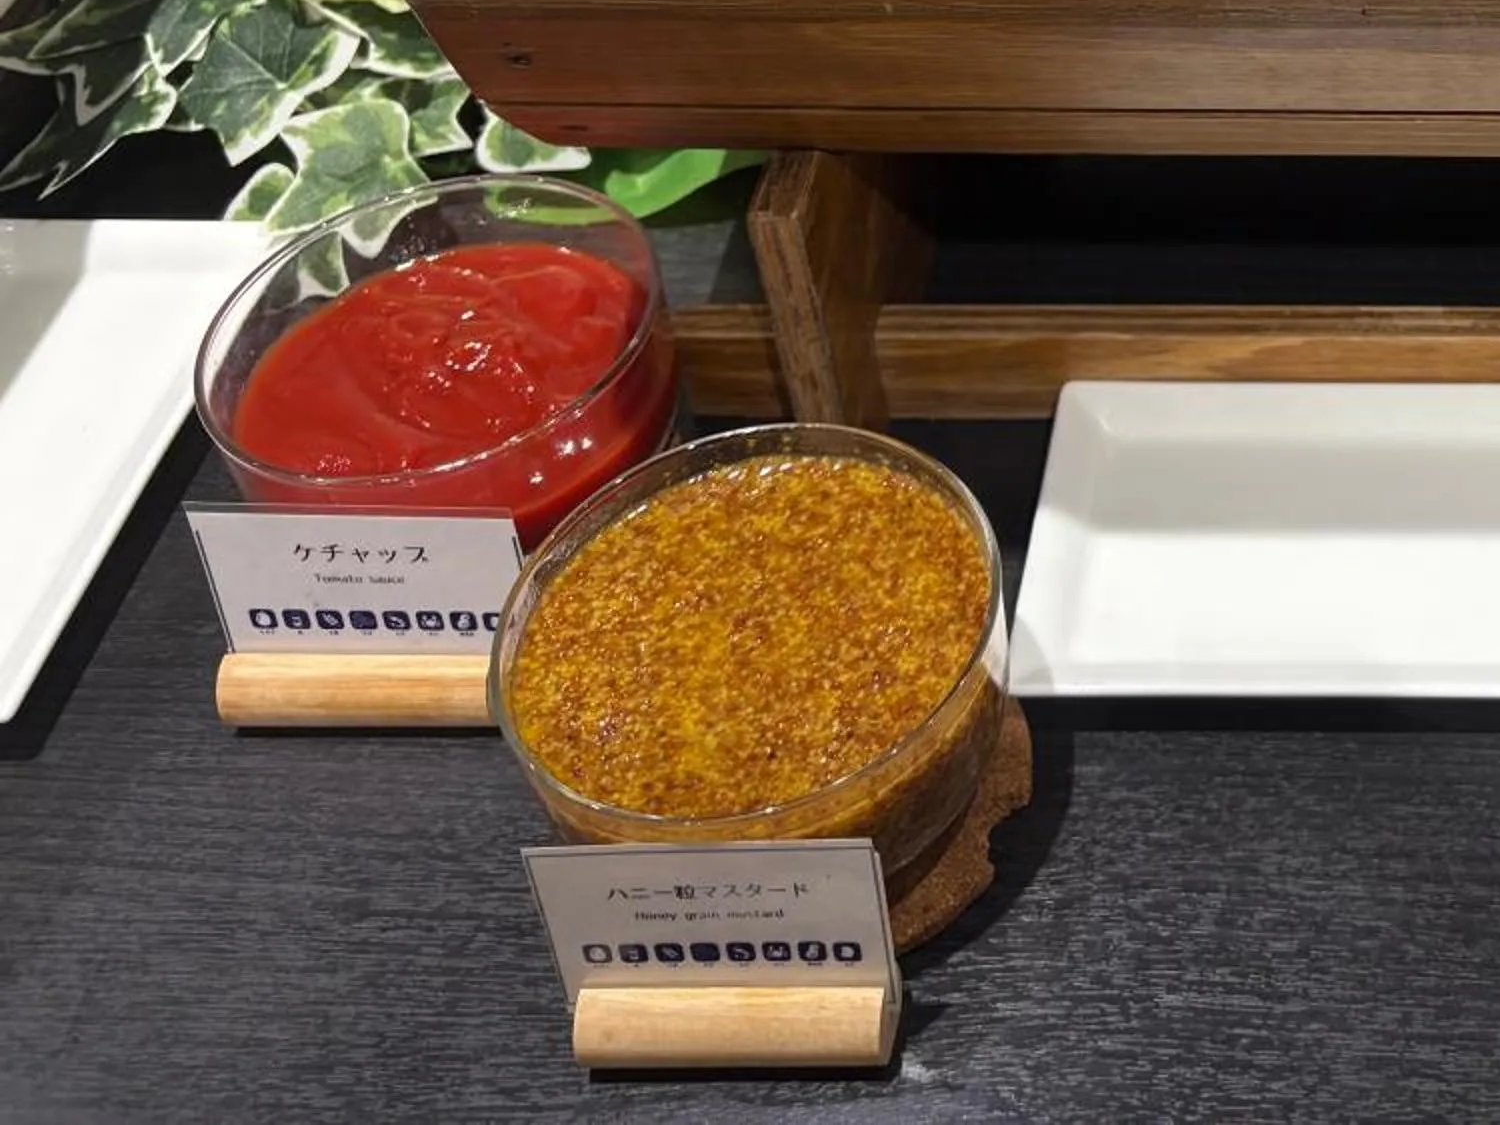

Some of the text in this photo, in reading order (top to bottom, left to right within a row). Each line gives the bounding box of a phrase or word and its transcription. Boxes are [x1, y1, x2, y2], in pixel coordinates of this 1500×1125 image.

[293, 543, 428, 563] ケチャップ
[313, 573, 405, 584] Tomato sauce
[607, 882, 808, 902] ハニー粒マスタード
[635, 911, 677, 921] Honey
